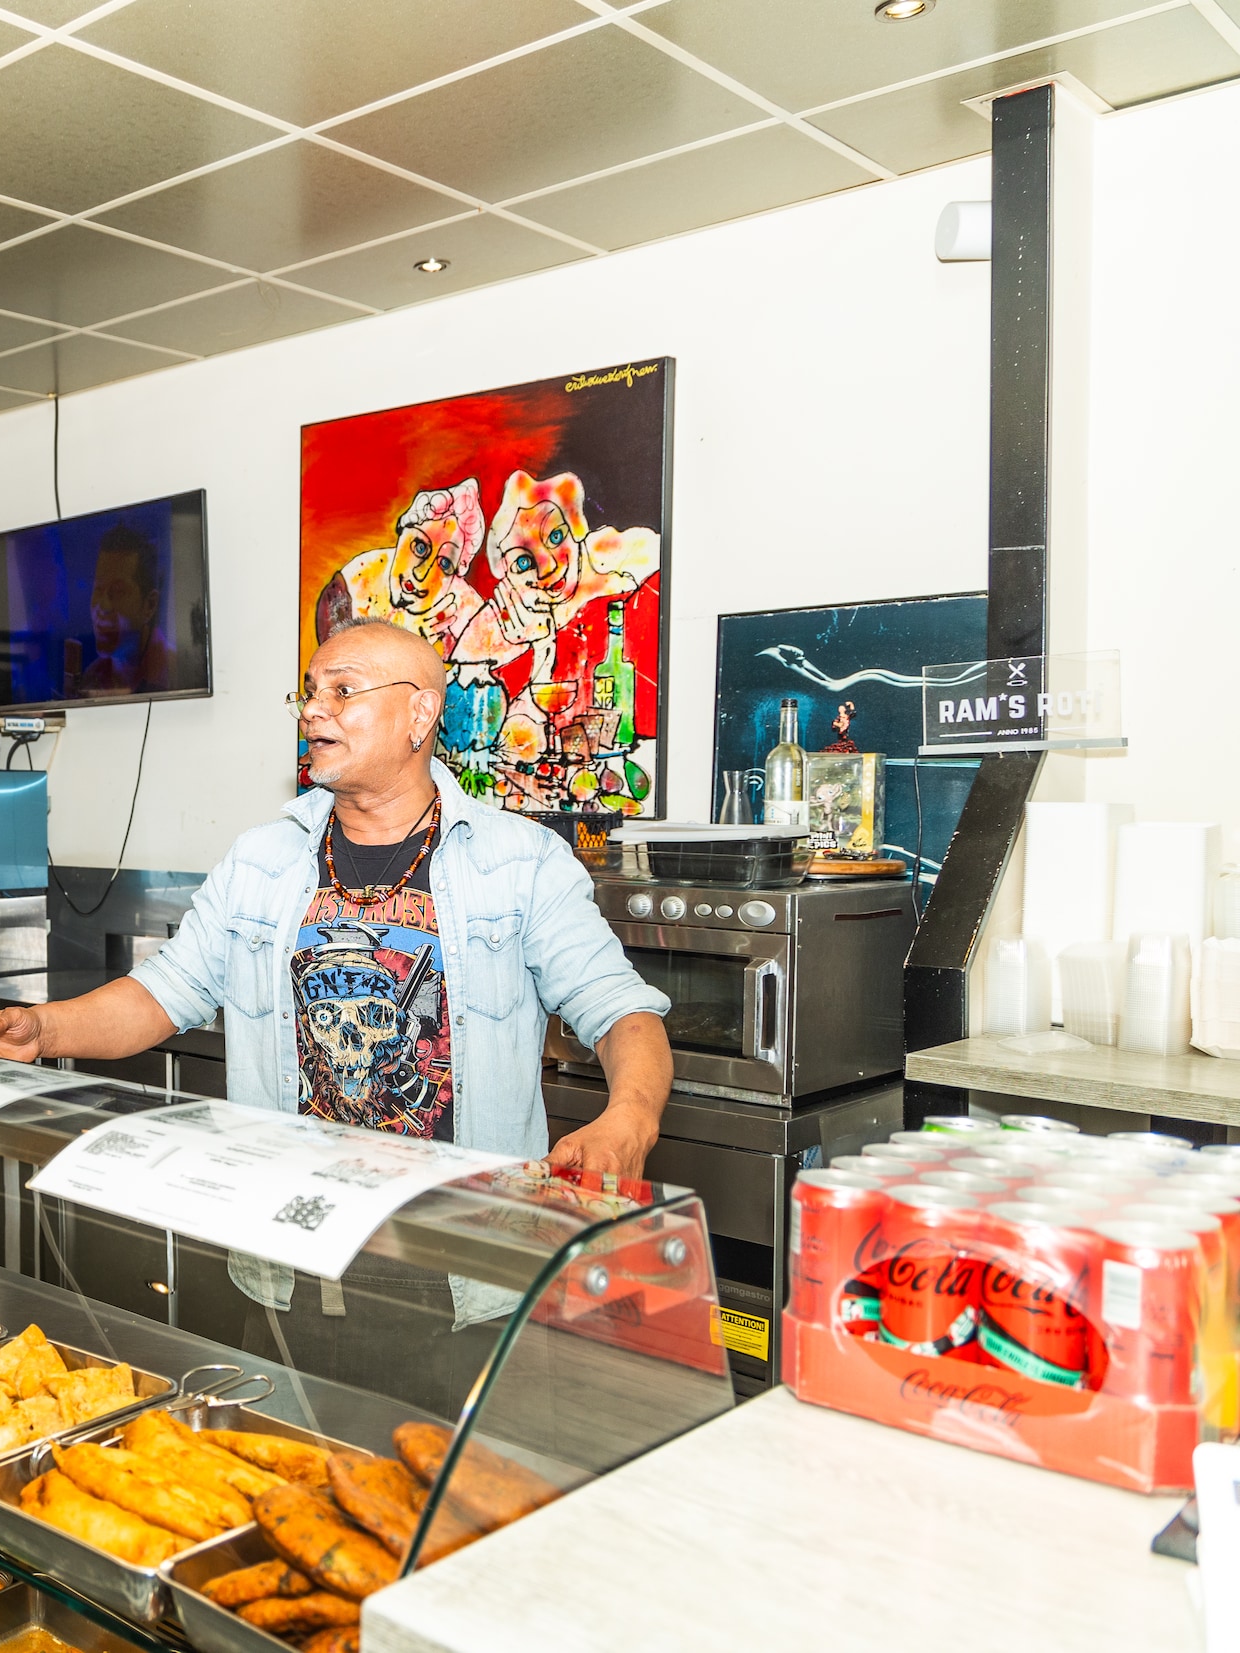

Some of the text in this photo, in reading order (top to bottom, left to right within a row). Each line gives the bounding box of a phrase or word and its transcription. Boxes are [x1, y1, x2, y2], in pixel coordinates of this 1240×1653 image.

[997, 728, 1019, 737] ANNO
[361, 887, 440, 936] ROSE
[721, 1312, 765, 1332] ATTENTION!
